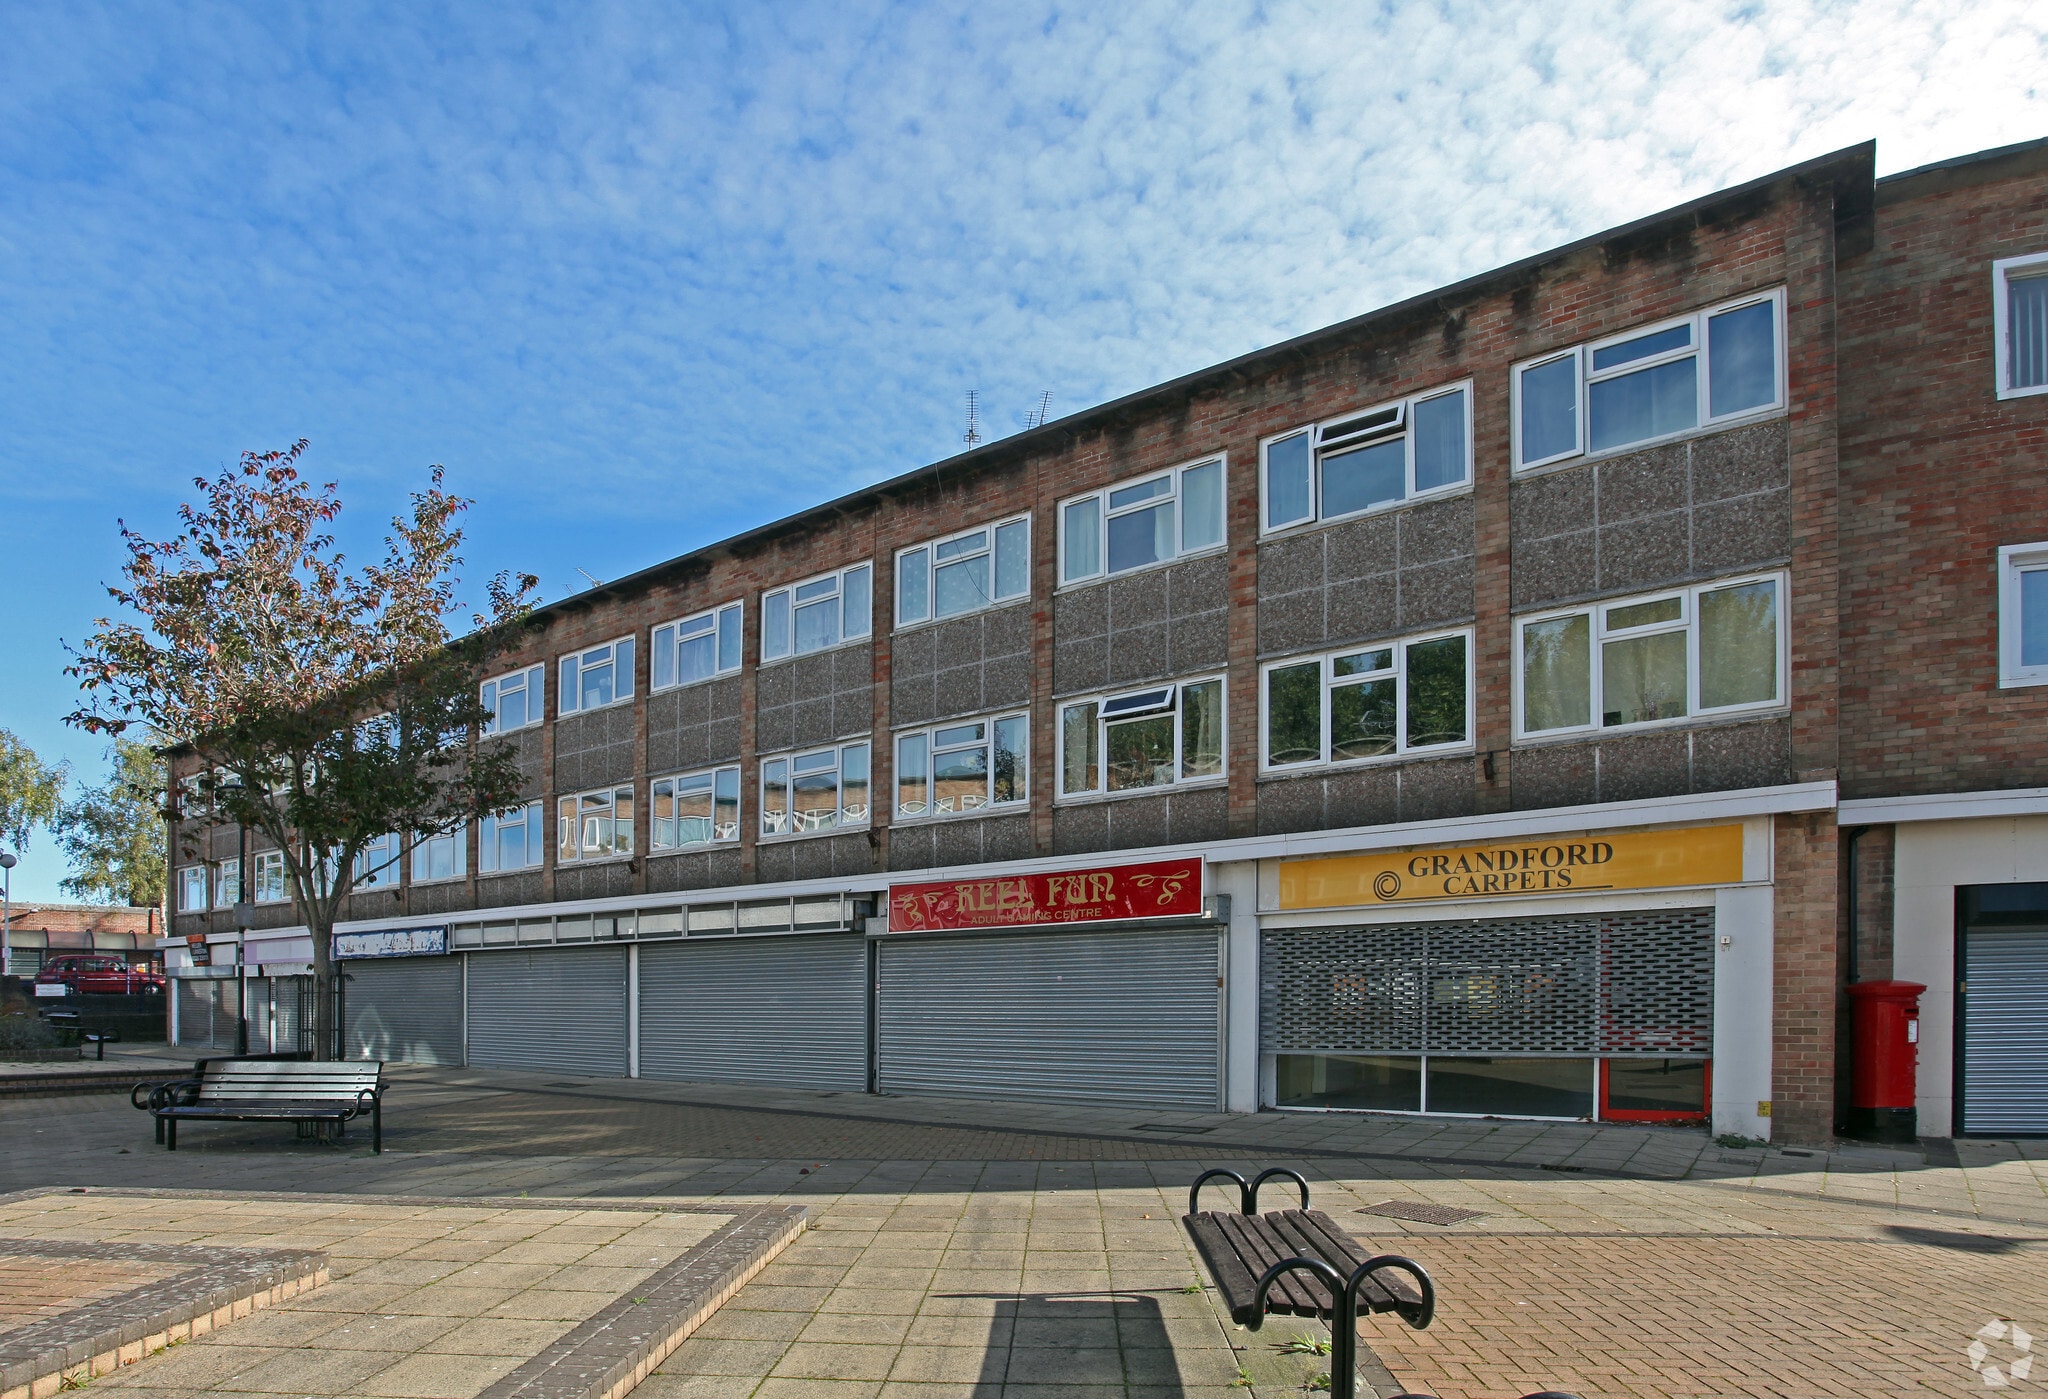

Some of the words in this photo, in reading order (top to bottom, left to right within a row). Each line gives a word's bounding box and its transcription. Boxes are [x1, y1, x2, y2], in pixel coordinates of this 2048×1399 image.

[1407, 842, 1613, 877] GRANDFORD
[955, 880, 1034, 912] REEL
[1046, 872, 1116, 907] FUN
[1443, 868, 1572, 895] CARPETS
[970, 914, 1004, 925] ADULT
[1007, 911, 1053, 923] GAMING
[1054, 907, 1103, 920] CENTRE
